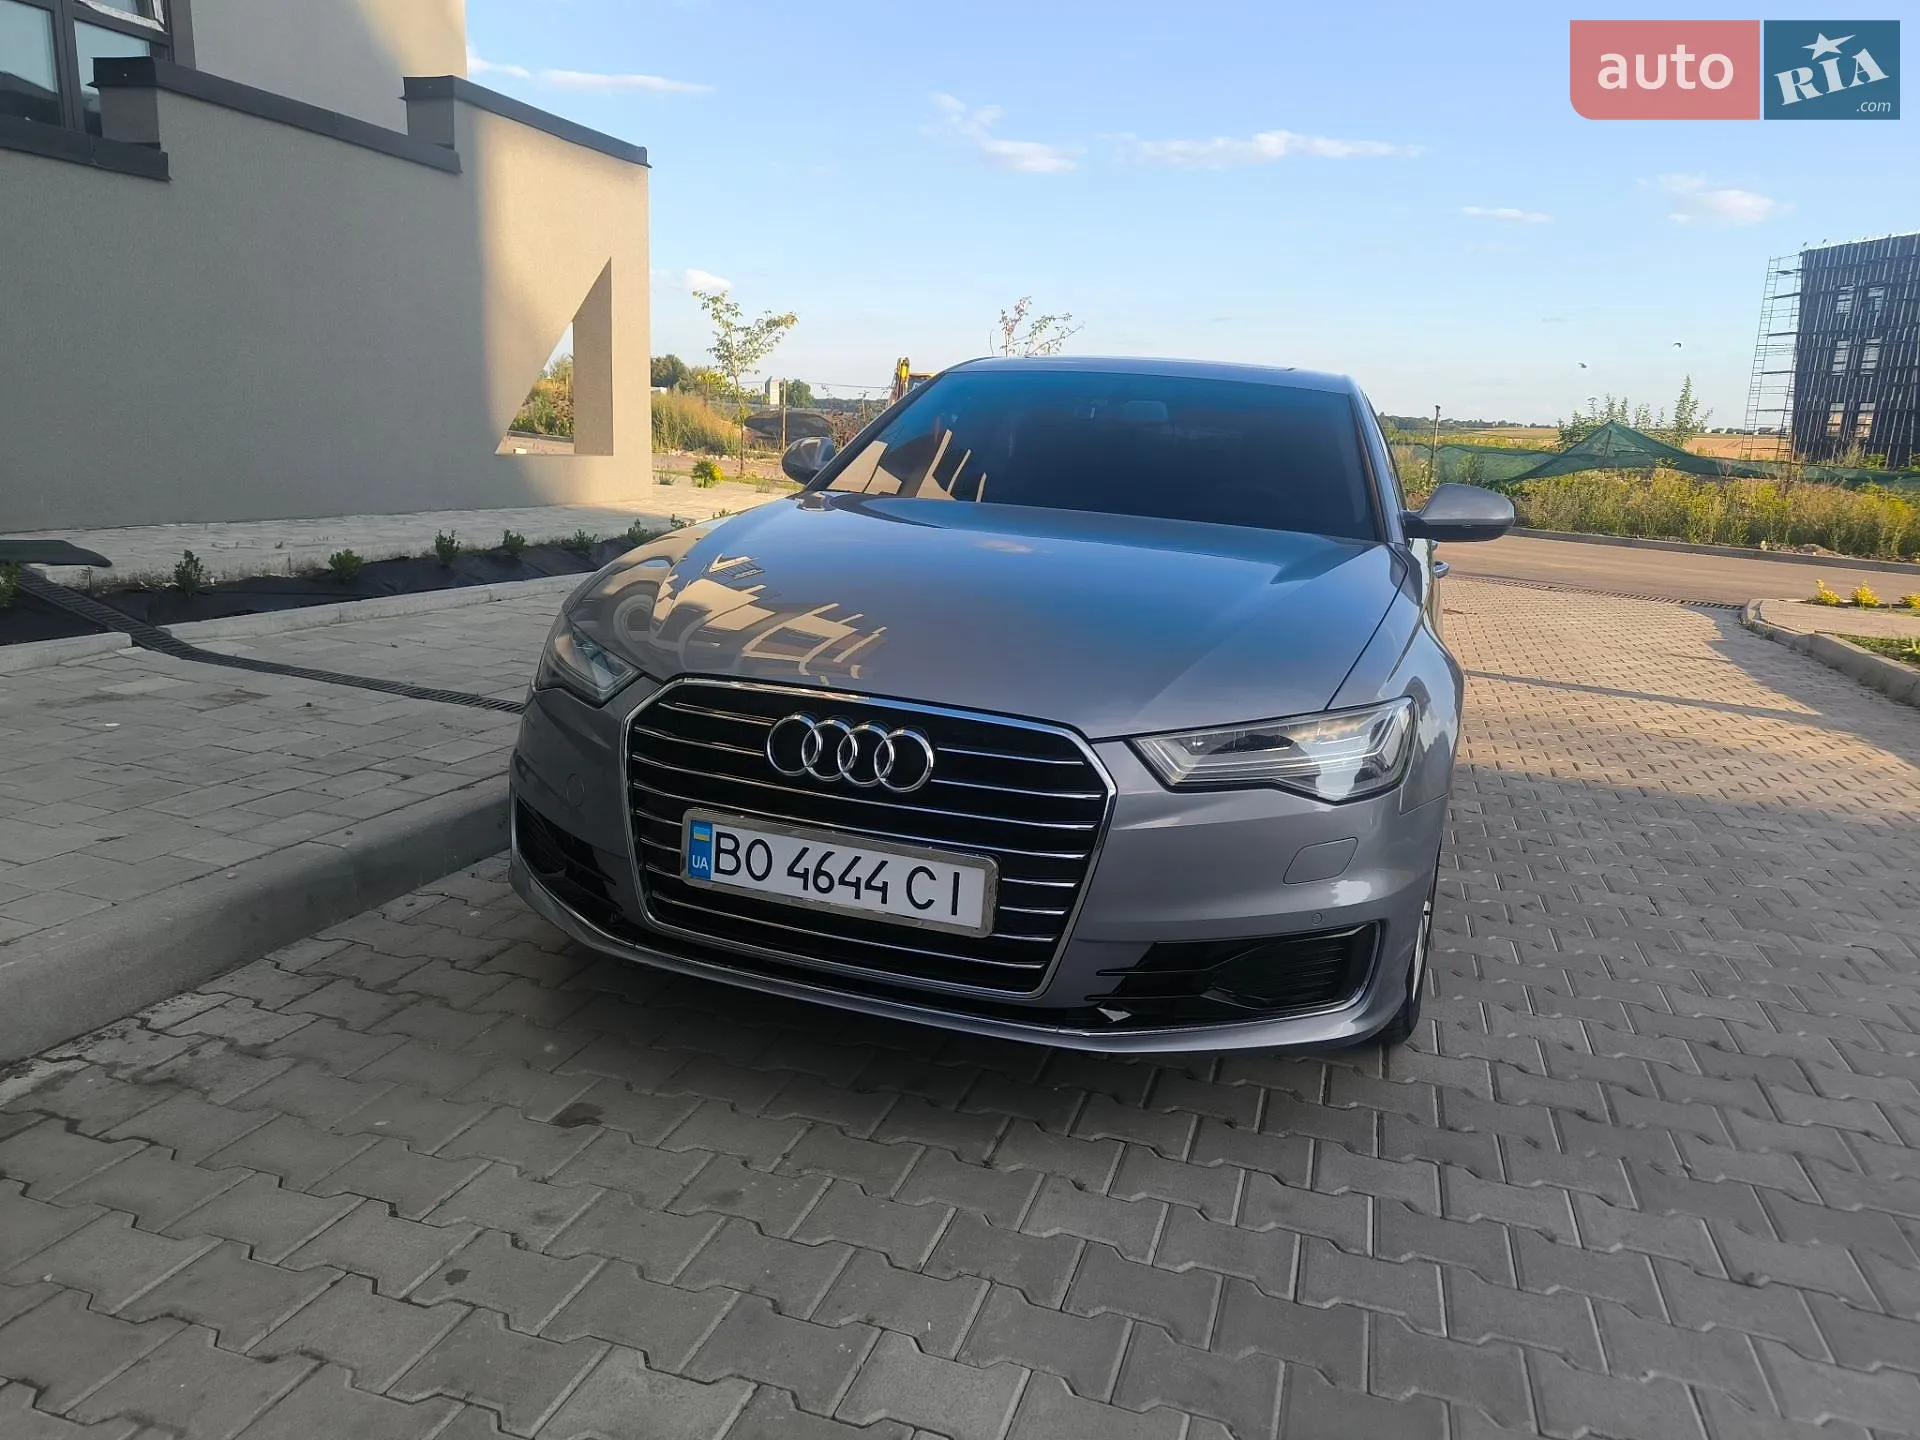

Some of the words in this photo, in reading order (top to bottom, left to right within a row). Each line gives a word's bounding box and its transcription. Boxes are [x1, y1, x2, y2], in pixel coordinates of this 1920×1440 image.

[692, 854, 709, 871] UA
[714, 831, 773, 881] BO
[787, 847, 889, 904] 4644
[906, 865, 960, 915] CI
